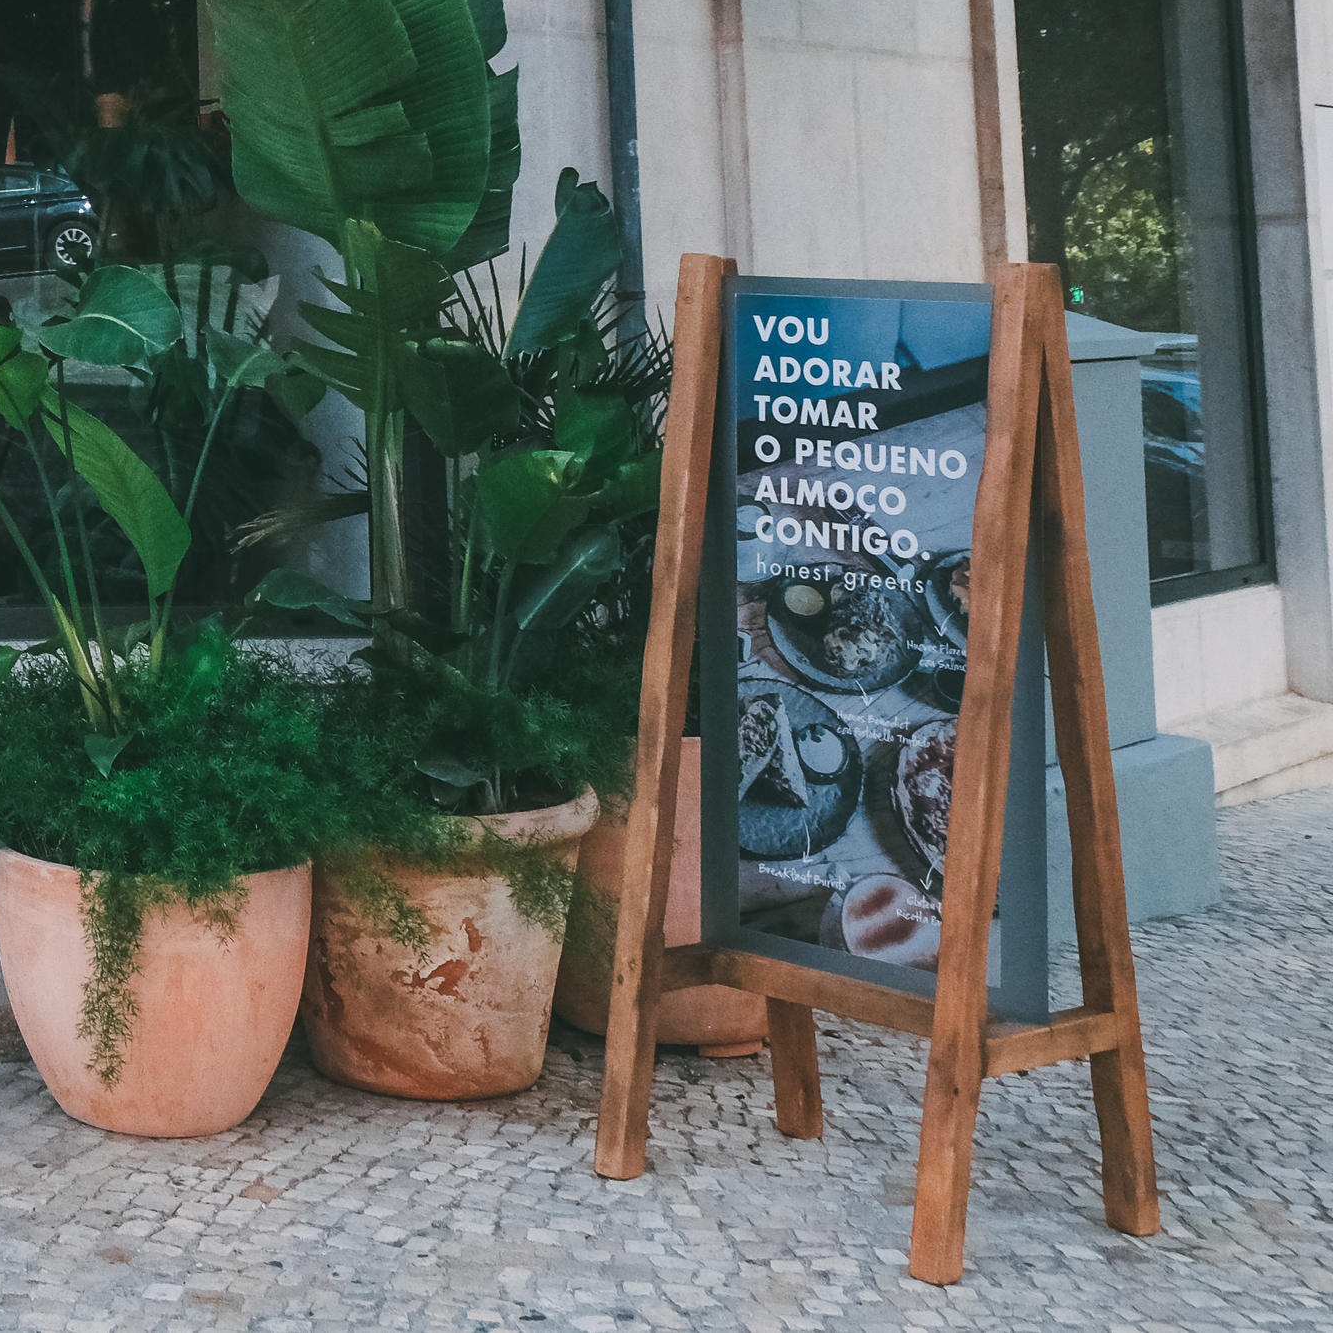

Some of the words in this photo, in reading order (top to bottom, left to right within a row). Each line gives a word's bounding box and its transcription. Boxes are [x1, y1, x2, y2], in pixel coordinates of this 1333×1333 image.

[753, 314, 830, 346] VOU
[753, 355, 902, 391] ADORAR
[753, 394, 880, 430] TOMAR
[754, 435, 781, 463] O
[794, 437, 968, 480] PEQUENO
[754, 475, 907, 519] ALMOÇO
[754, 514, 931, 562] CONTIGO.
[756, 552, 831, 582] honest
[843, 570, 925, 594] greens
[758, 862, 813, 885] Breakfast
